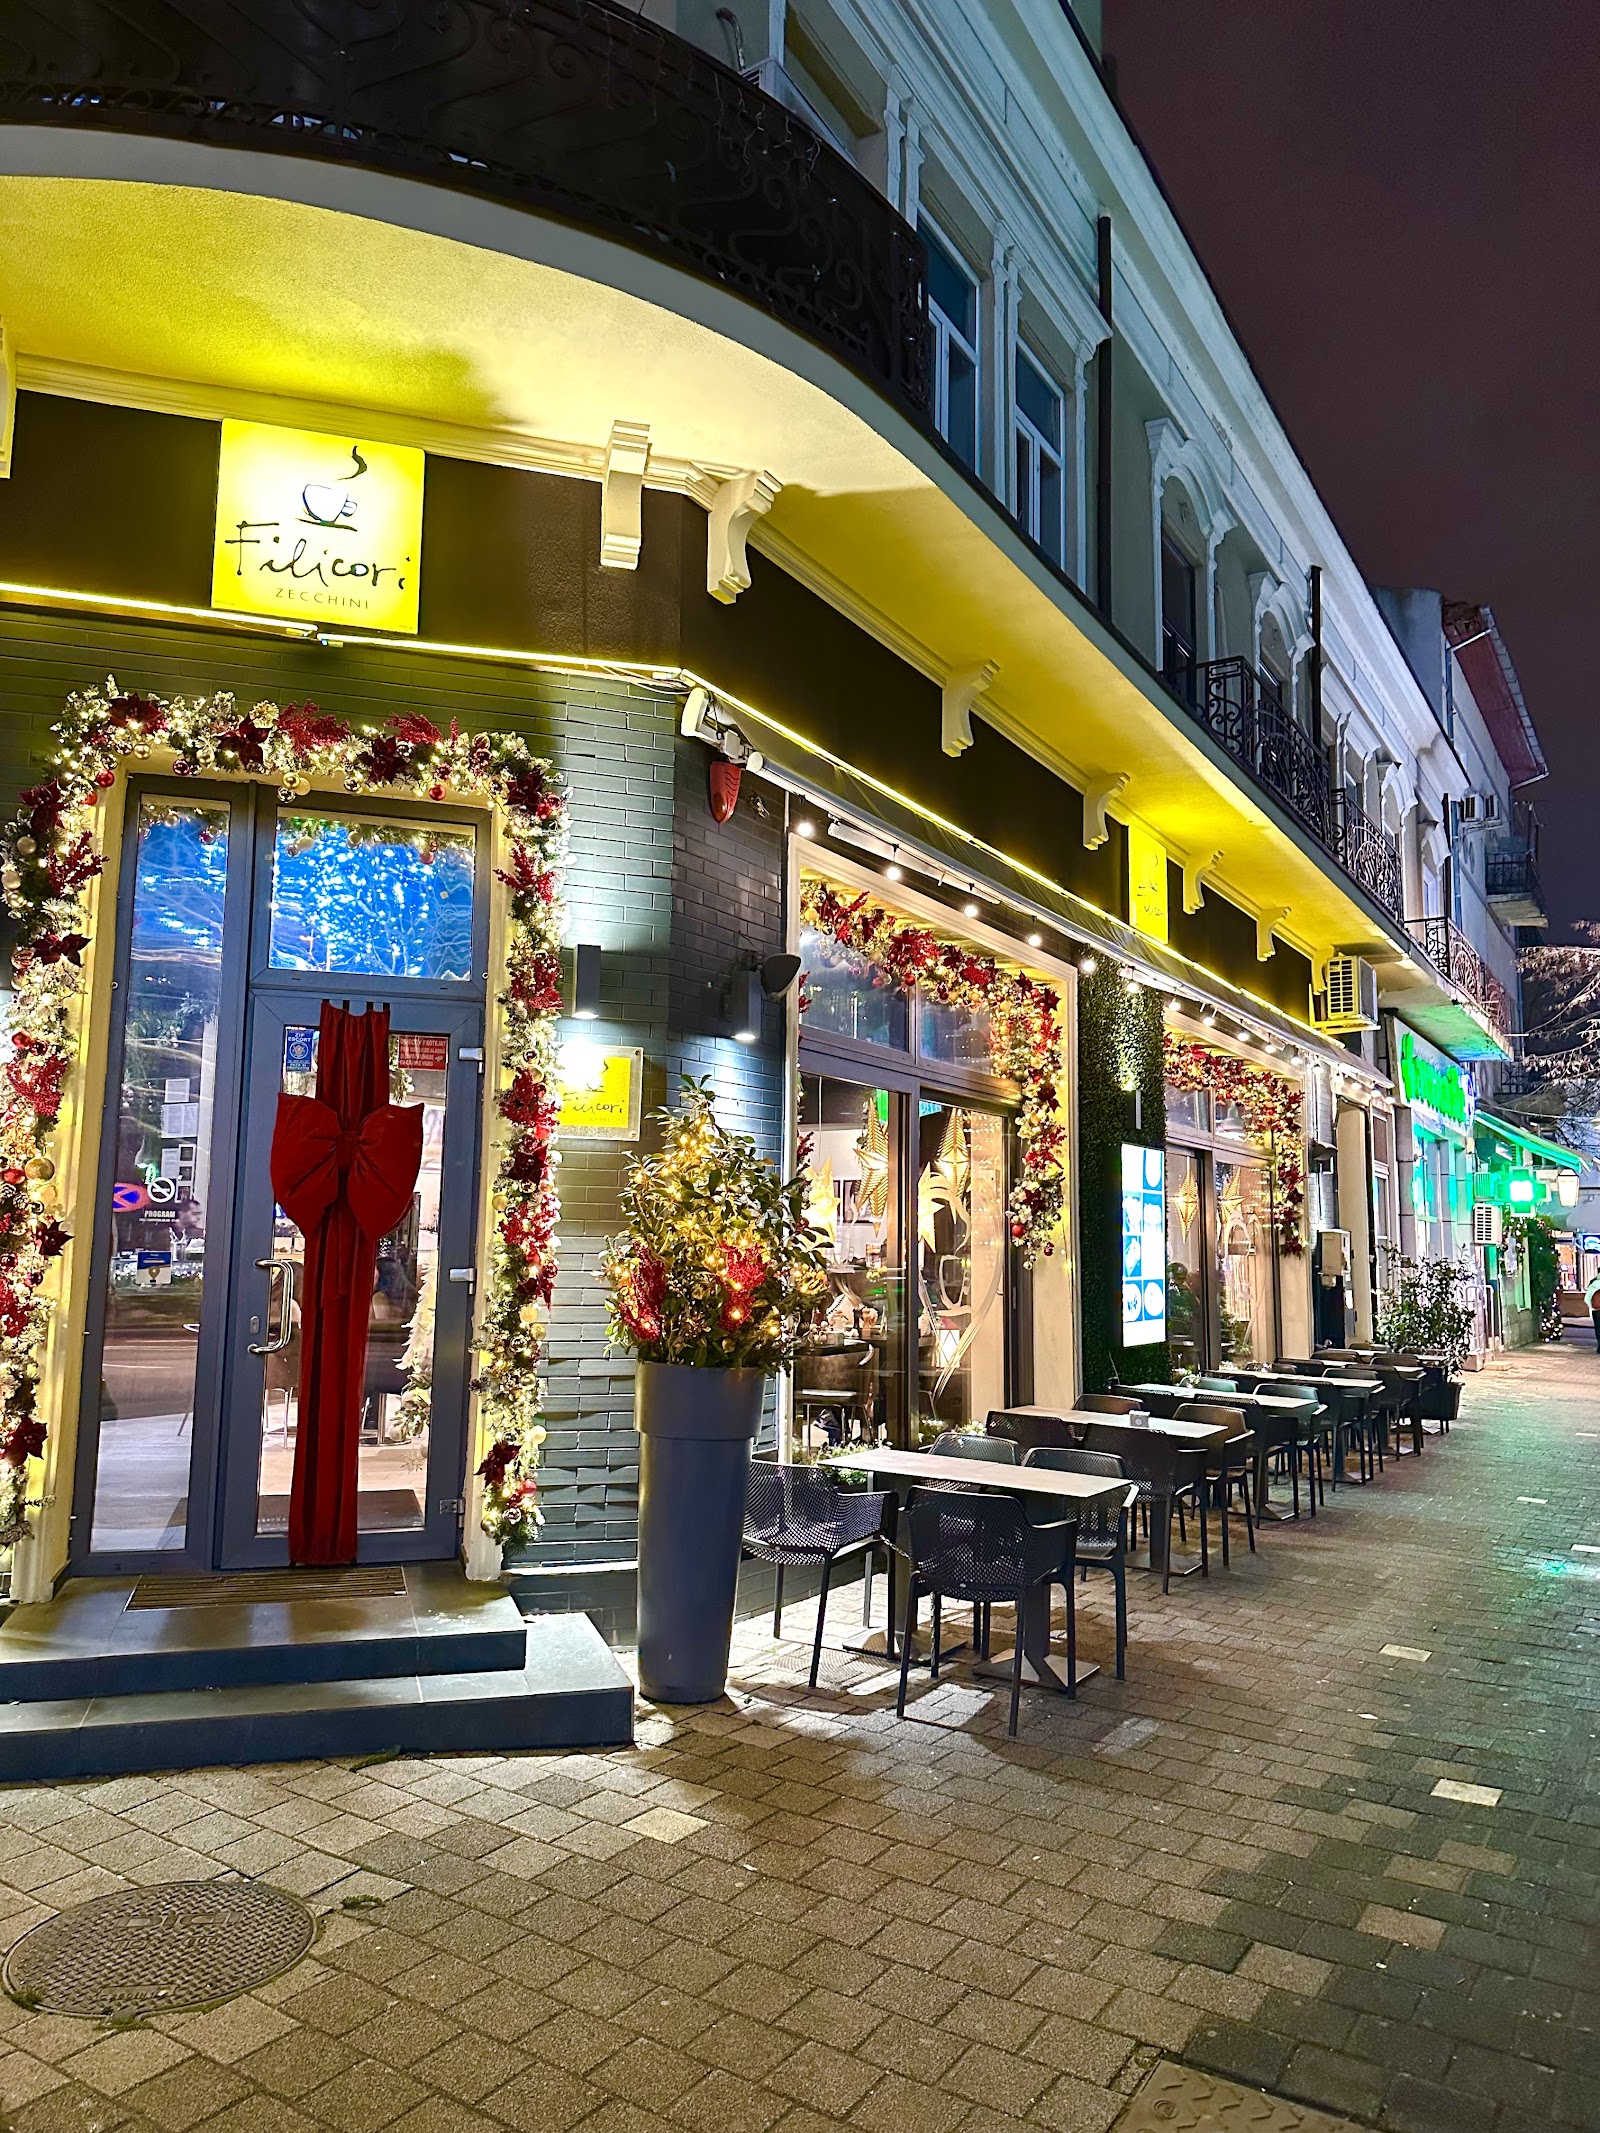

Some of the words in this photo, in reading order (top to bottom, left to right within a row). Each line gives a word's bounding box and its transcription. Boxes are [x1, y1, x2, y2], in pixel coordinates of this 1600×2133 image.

[225, 520, 411, 590] Filicori
[276, 587, 369, 610] ZECCHINI
[144, 1210, 176, 1218] PROGRAM
